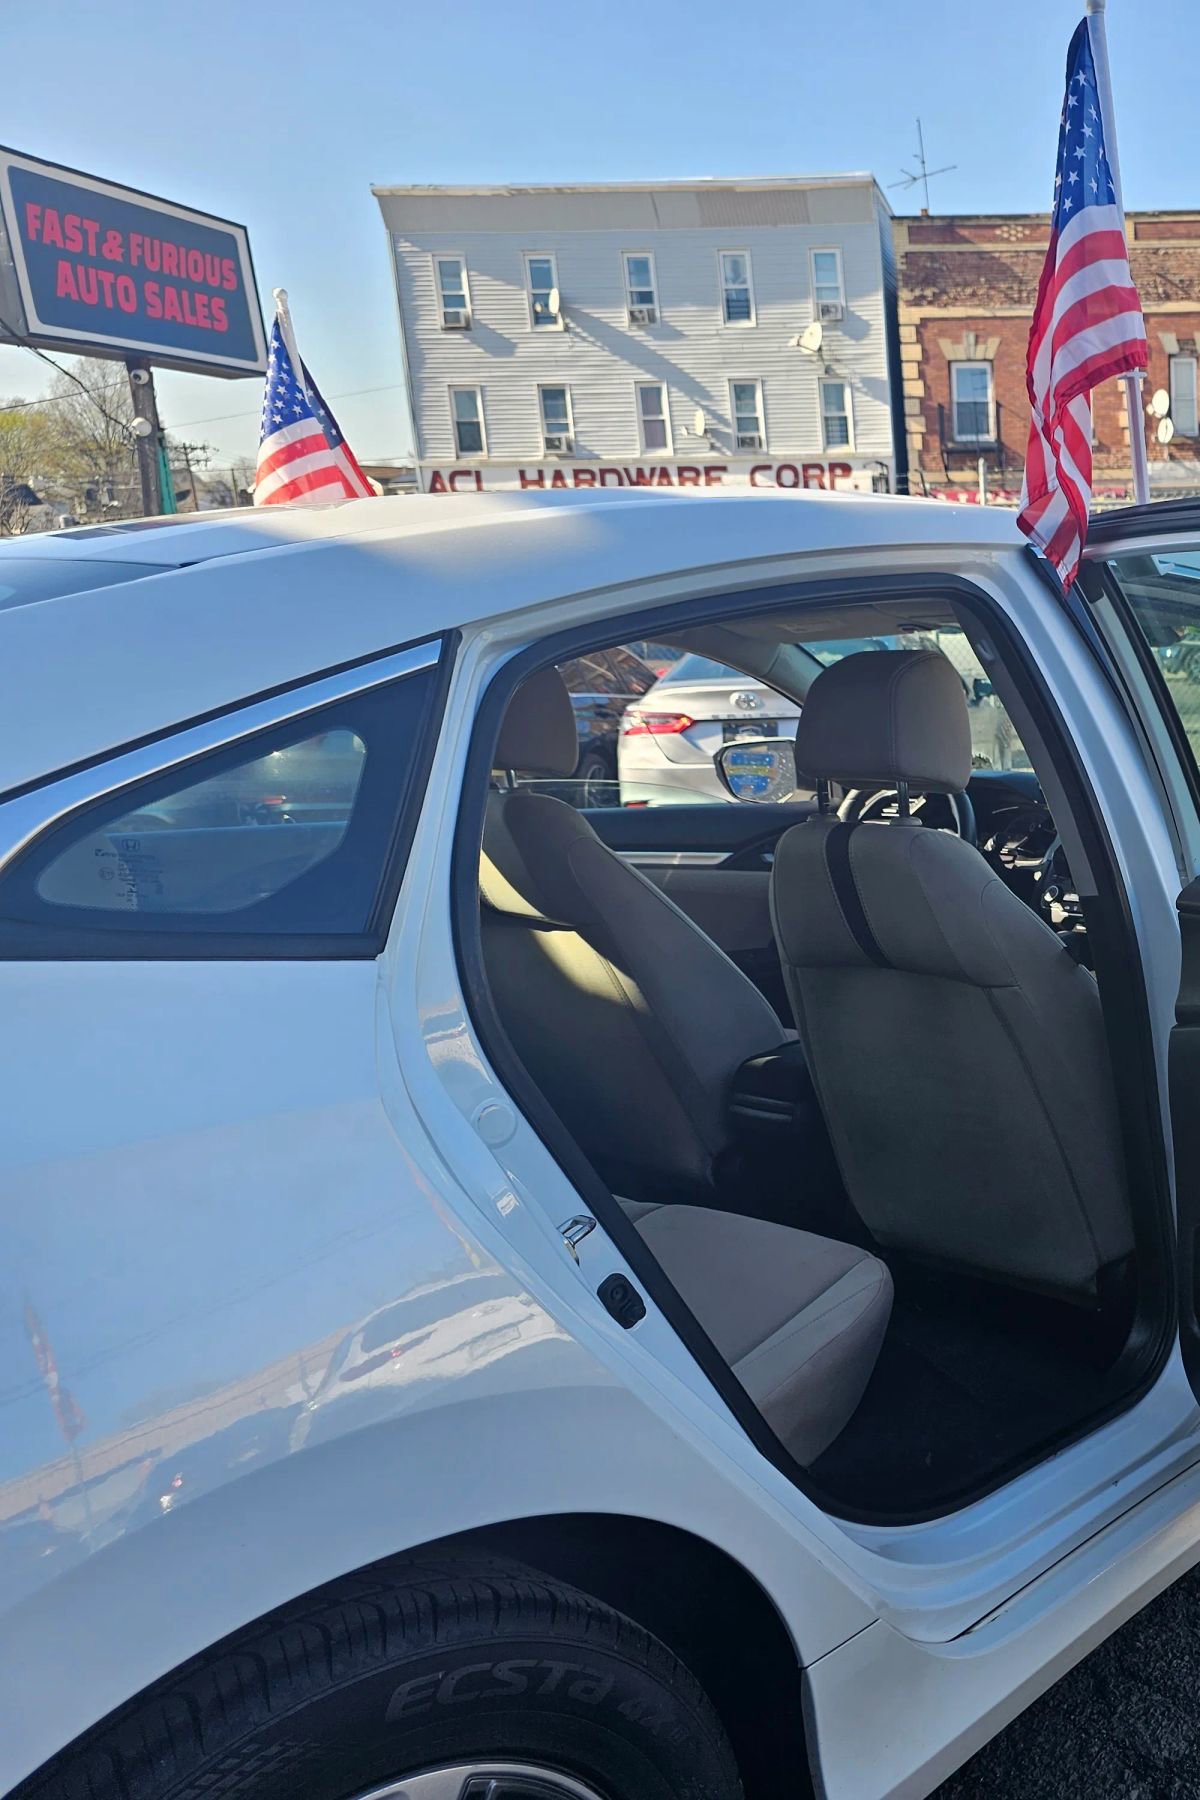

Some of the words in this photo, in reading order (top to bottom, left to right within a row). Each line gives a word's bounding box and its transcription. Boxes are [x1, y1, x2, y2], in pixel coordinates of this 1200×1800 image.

[25, 203, 99, 257] FAST
[102, 230, 125, 263] &
[129, 232, 238, 290] FURIOUS
[56, 260, 137, 314] AUTO
[144, 281, 229, 333] SALES
[518, 465, 728, 489] HARDWARE
